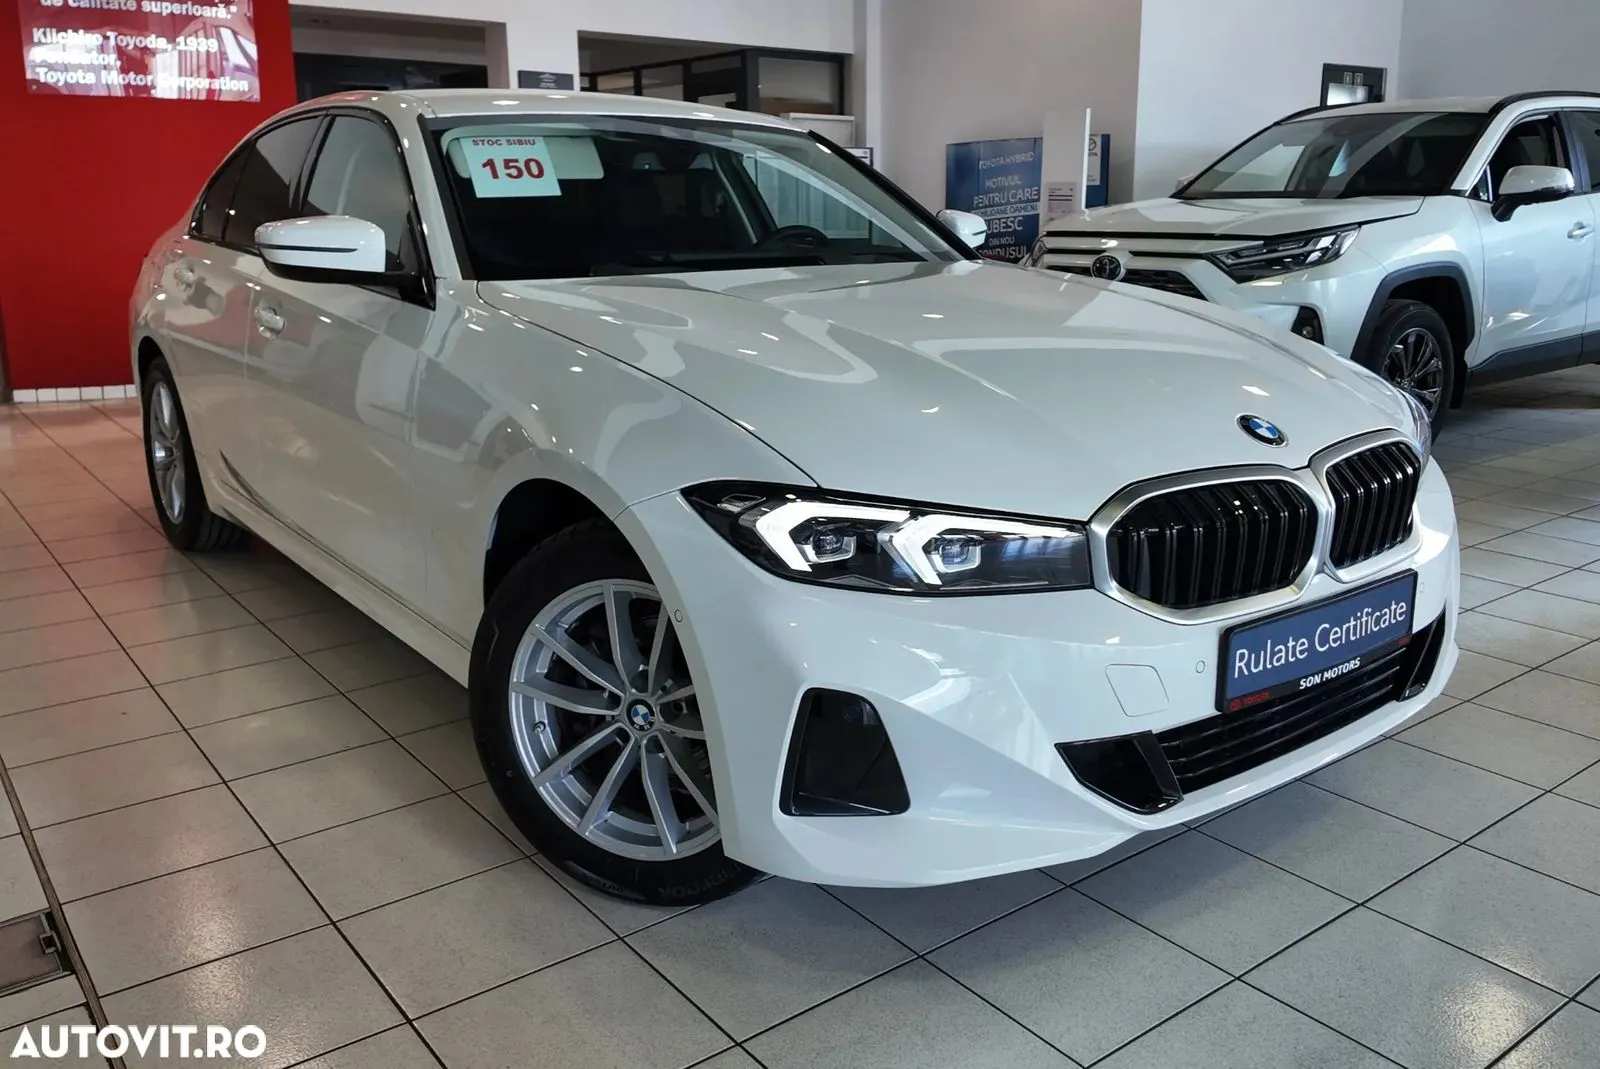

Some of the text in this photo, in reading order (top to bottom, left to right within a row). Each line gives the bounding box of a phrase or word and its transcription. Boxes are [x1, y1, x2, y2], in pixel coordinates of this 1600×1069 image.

[175, 35, 219, 53] 1939
[35, 66, 249, 92] Toyota Motor Crporation
[472, 138, 537, 147] STOC SIBIU
[481, 157, 545, 180] 150
[985, 175, 1021, 188] MOTIVUL
[974, 192, 1008, 207] PENTRU
[1008, 186, 1039, 202] CARE
[1234, 600, 1407, 679] Rulate Certificate
[1299, 656, 1361, 690] SON MOTORS
